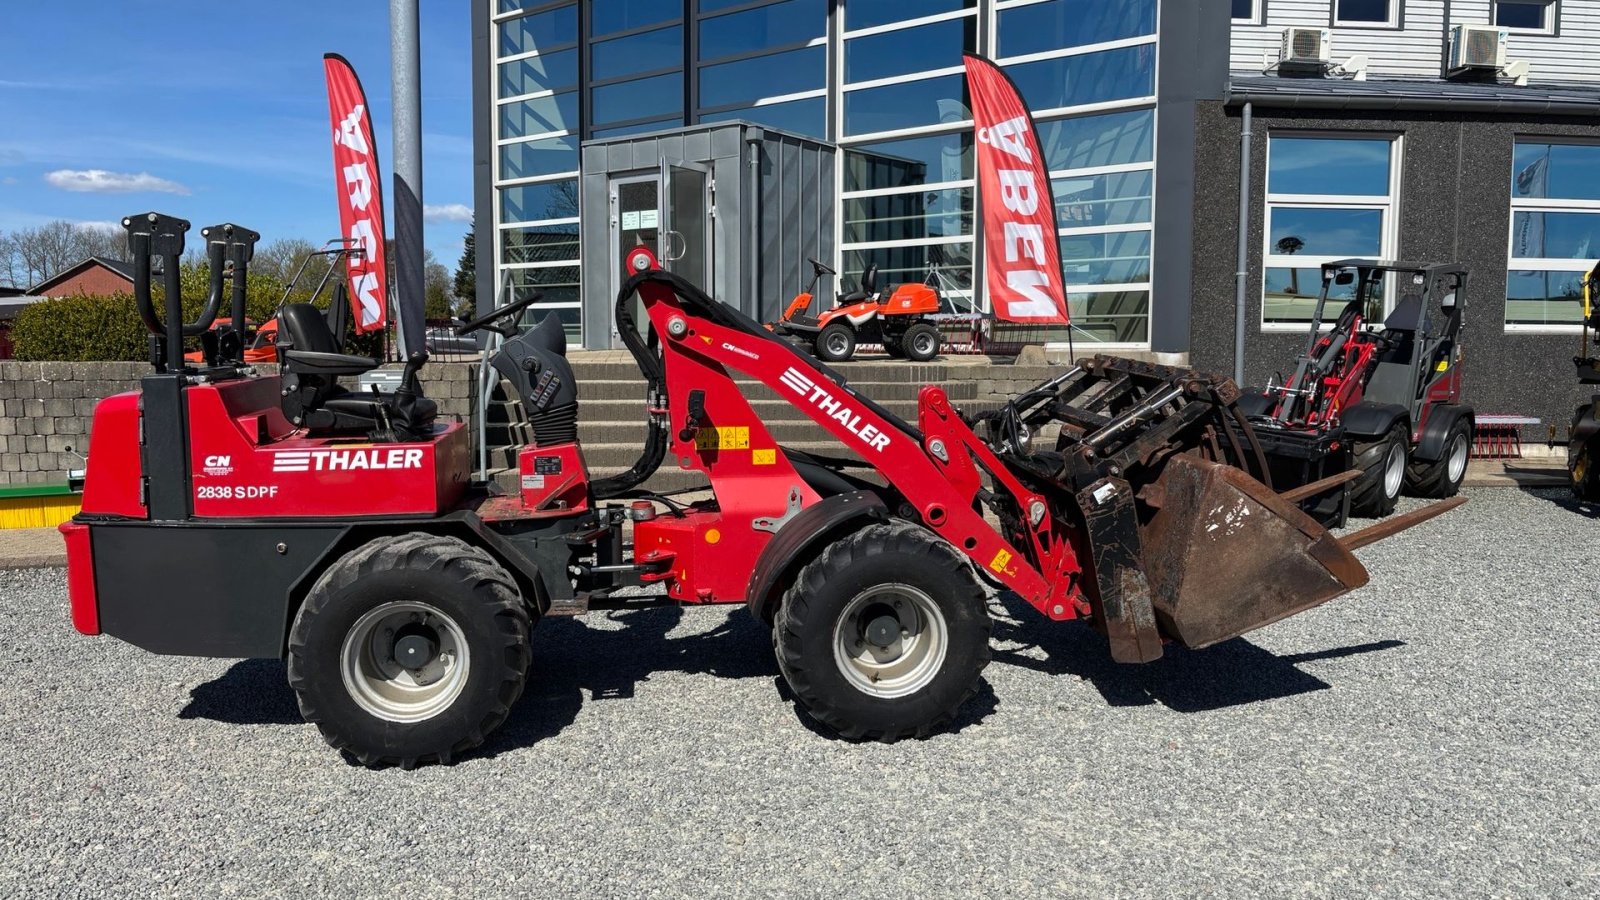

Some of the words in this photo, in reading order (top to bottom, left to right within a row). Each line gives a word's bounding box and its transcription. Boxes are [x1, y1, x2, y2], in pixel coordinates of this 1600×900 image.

[808, 384, 891, 453] THALER
[204, 455, 231, 467] CN
[311, 449, 424, 471] THALER
[197, 486, 233, 499] 2838
